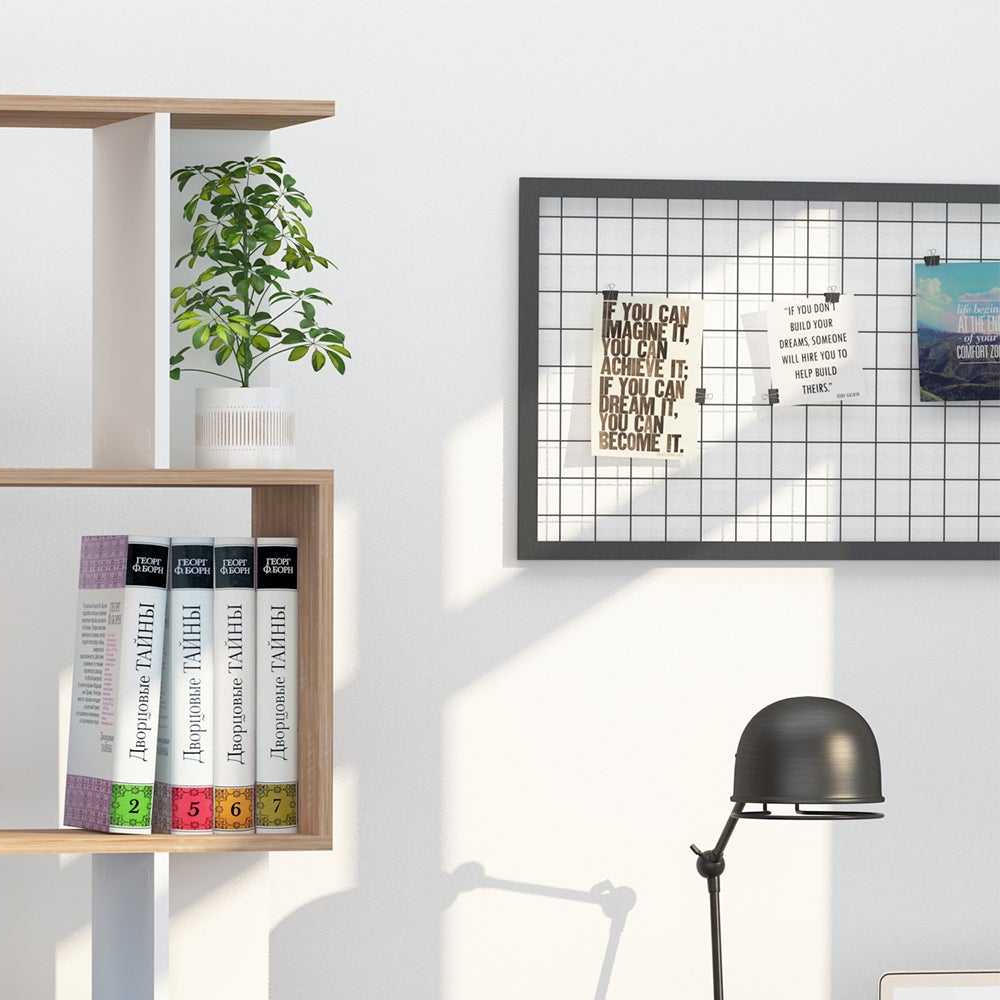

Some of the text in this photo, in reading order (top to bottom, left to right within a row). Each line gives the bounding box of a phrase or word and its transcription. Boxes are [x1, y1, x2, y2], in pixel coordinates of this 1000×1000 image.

[603, 302, 690, 325] IF YOU CAN
[797, 304, 812, 314] YOU
[814, 302, 836, 313] DON'T
[957, 304, 971, 315] life
[602, 319, 690, 345] IMAGINE IT,
[790, 318, 833, 331] BUILD YOUR
[958, 316, 969, 333] AT
[970, 316, 985, 333] THE
[779, 333, 847, 349] DREAMS, SOMEONE
[964, 333, 997, 345] of your
[602, 338, 668, 359] YOU CAN
[956, 345, 988, 359] COMFORT
[782, 349, 847, 365] WILL HIRE YOU TO
[600, 357, 664, 378] ACHIEVE
[795, 366, 837, 379] HELP BUILD
[600, 376, 685, 399] IF YOU CAN
[600, 395, 678, 419] DREAM IT,
[600, 413, 664, 434] YOU CAN
[599, 431, 684, 453] BECOME IT.
[136, 556, 162, 566] ГЕОРГ
[178, 558, 208, 566] ГЕОРГ
[129, 602, 155, 762] Дворцовые ТАЙНЫ
[179, 605, 207, 763] Дворцовые ТАЙНЫ
[224, 604, 247, 765] Дворцовые ТАЙНЫ
[267, 606, 290, 760] Дворцовые ТАЙНЫ
[129, 799, 140, 814] 2
[188, 802, 200, 817] 5
[231, 802, 241, 817] 6
[273, 799, 282, 813] 7
